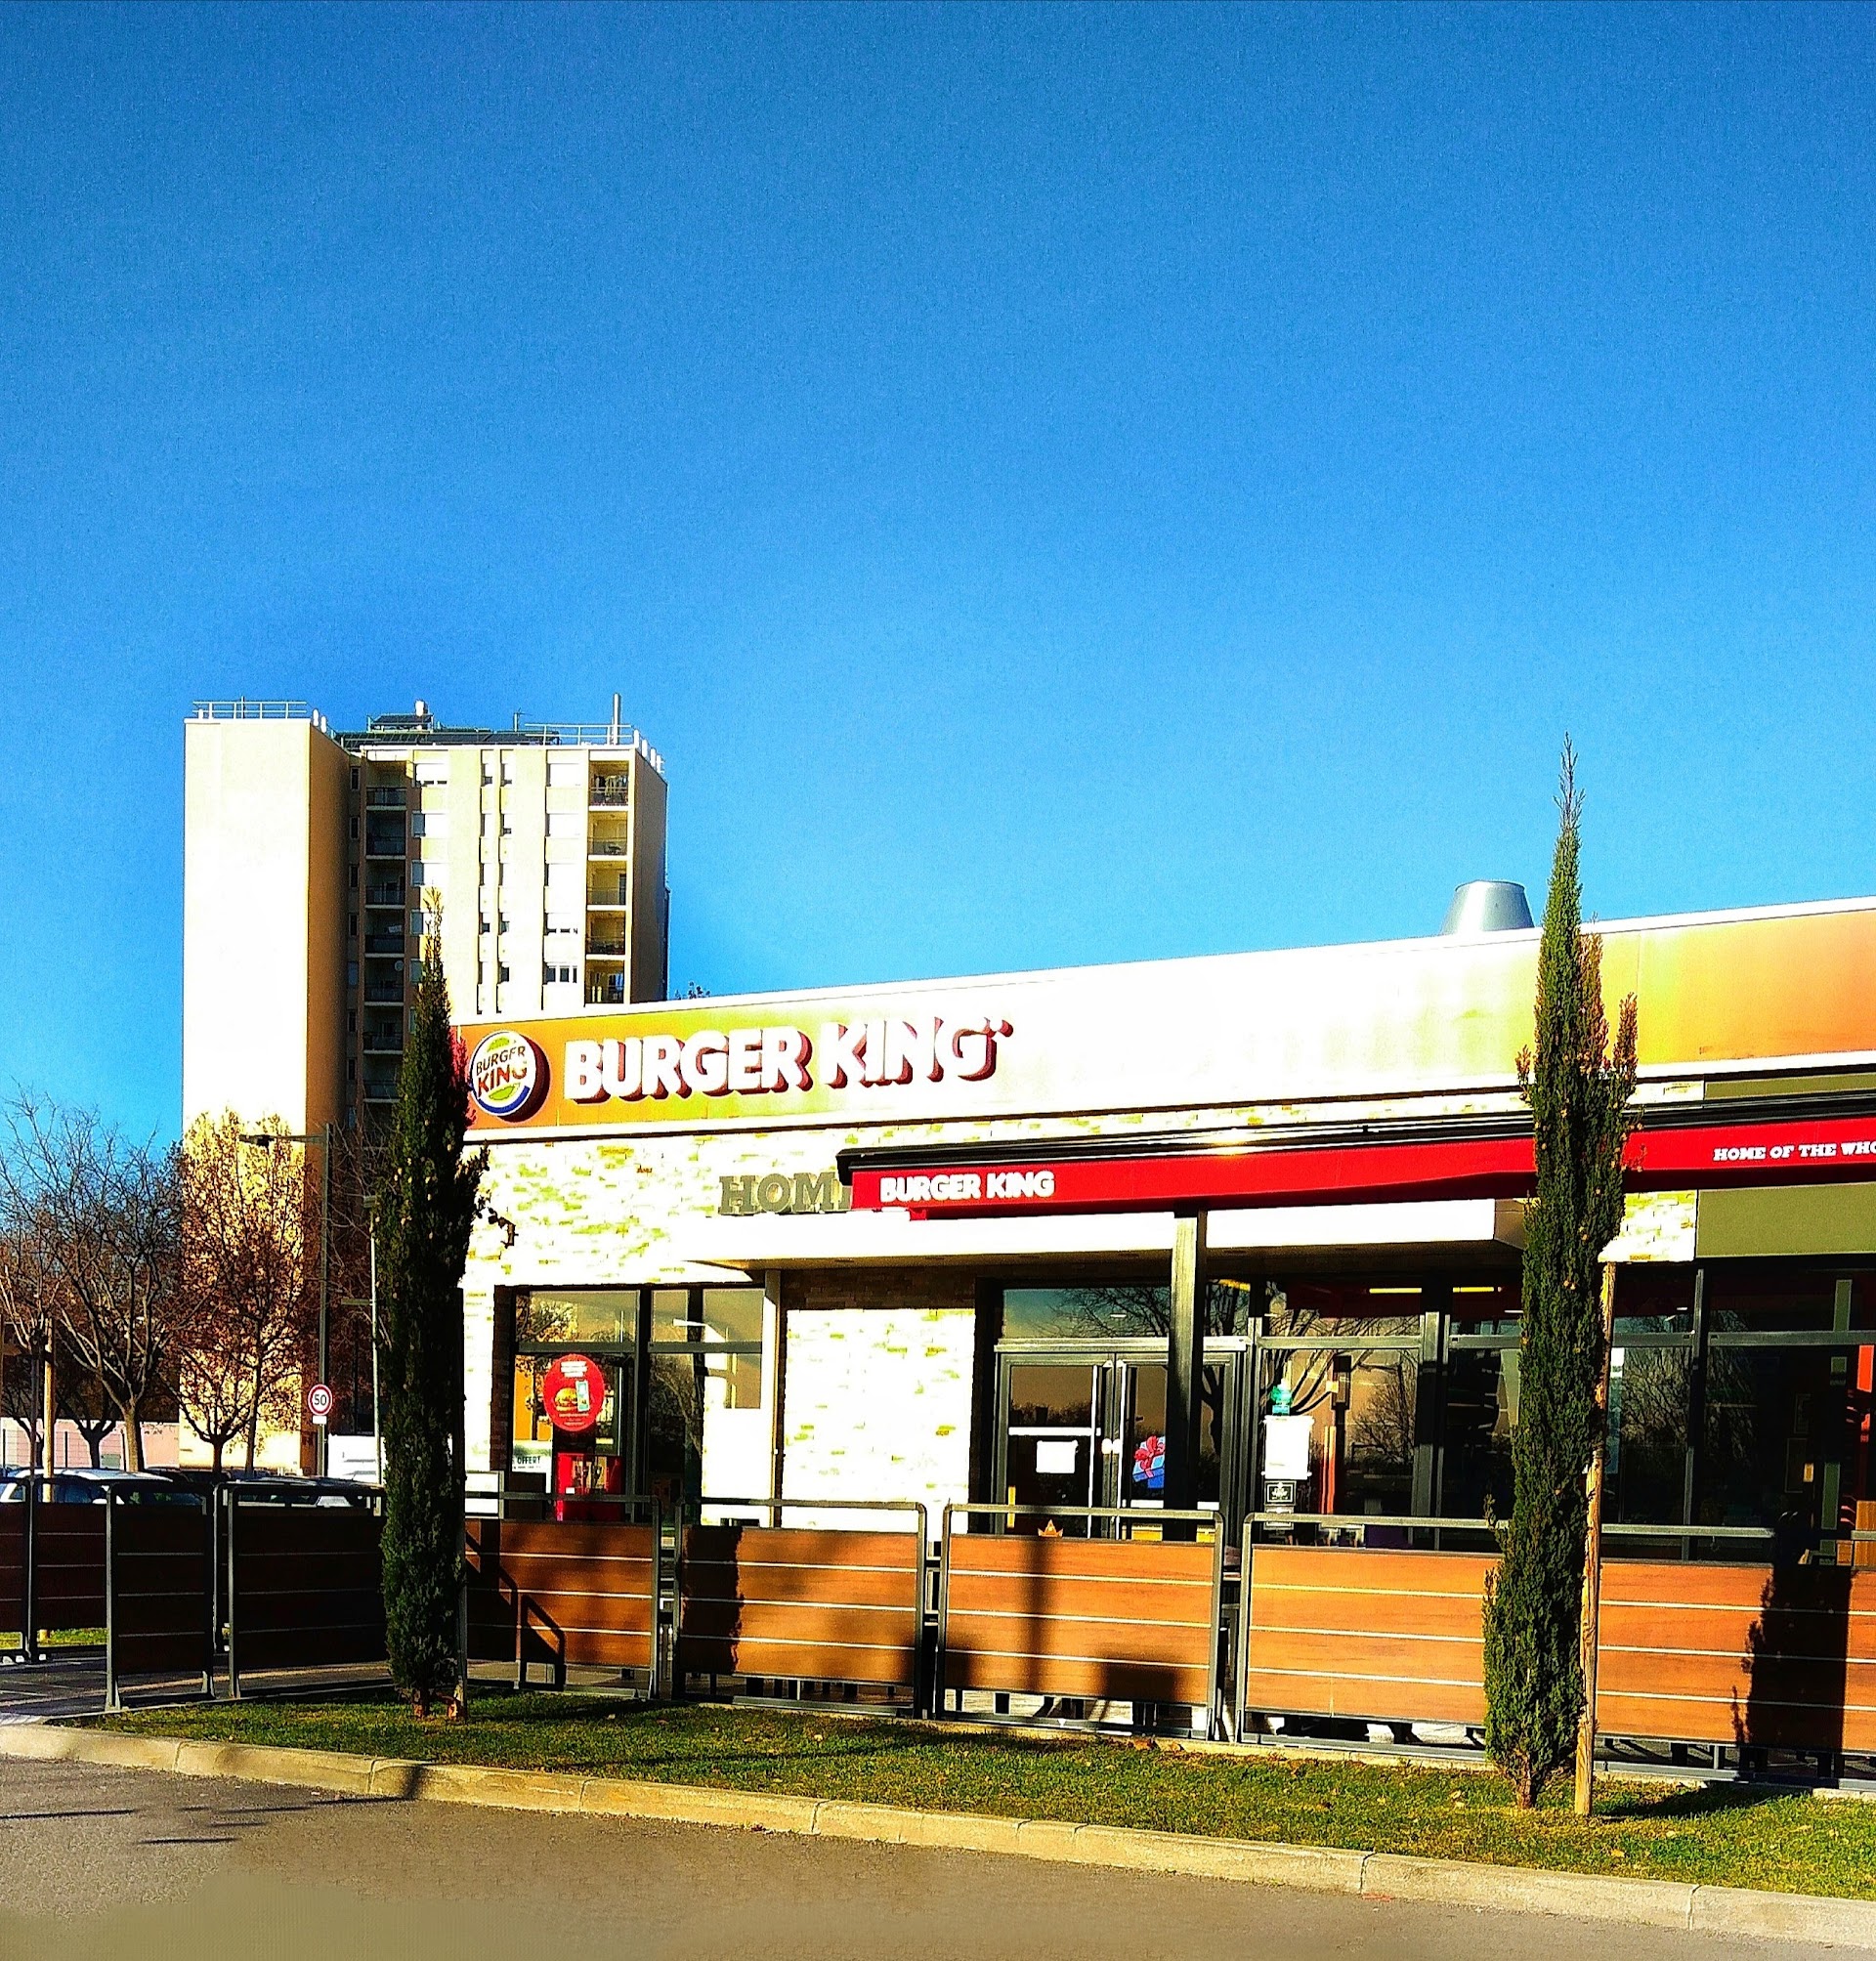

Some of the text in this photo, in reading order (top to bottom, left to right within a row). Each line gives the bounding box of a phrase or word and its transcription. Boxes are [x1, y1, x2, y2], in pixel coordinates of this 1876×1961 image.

[476, 1045, 526, 1076] BURGER
[564, 1016, 998, 1104] BURGER KING
[478, 1064, 528, 1097] KING
[1713, 1146, 1767, 1161] HOME
[1769, 1145, 1795, 1159] OF
[1798, 1143, 1837, 1158] THE
[718, 1172, 852, 1216] HOM
[880, 1171, 1055, 1203] BURGER KING
[314, 1394, 327, 1406] 50
